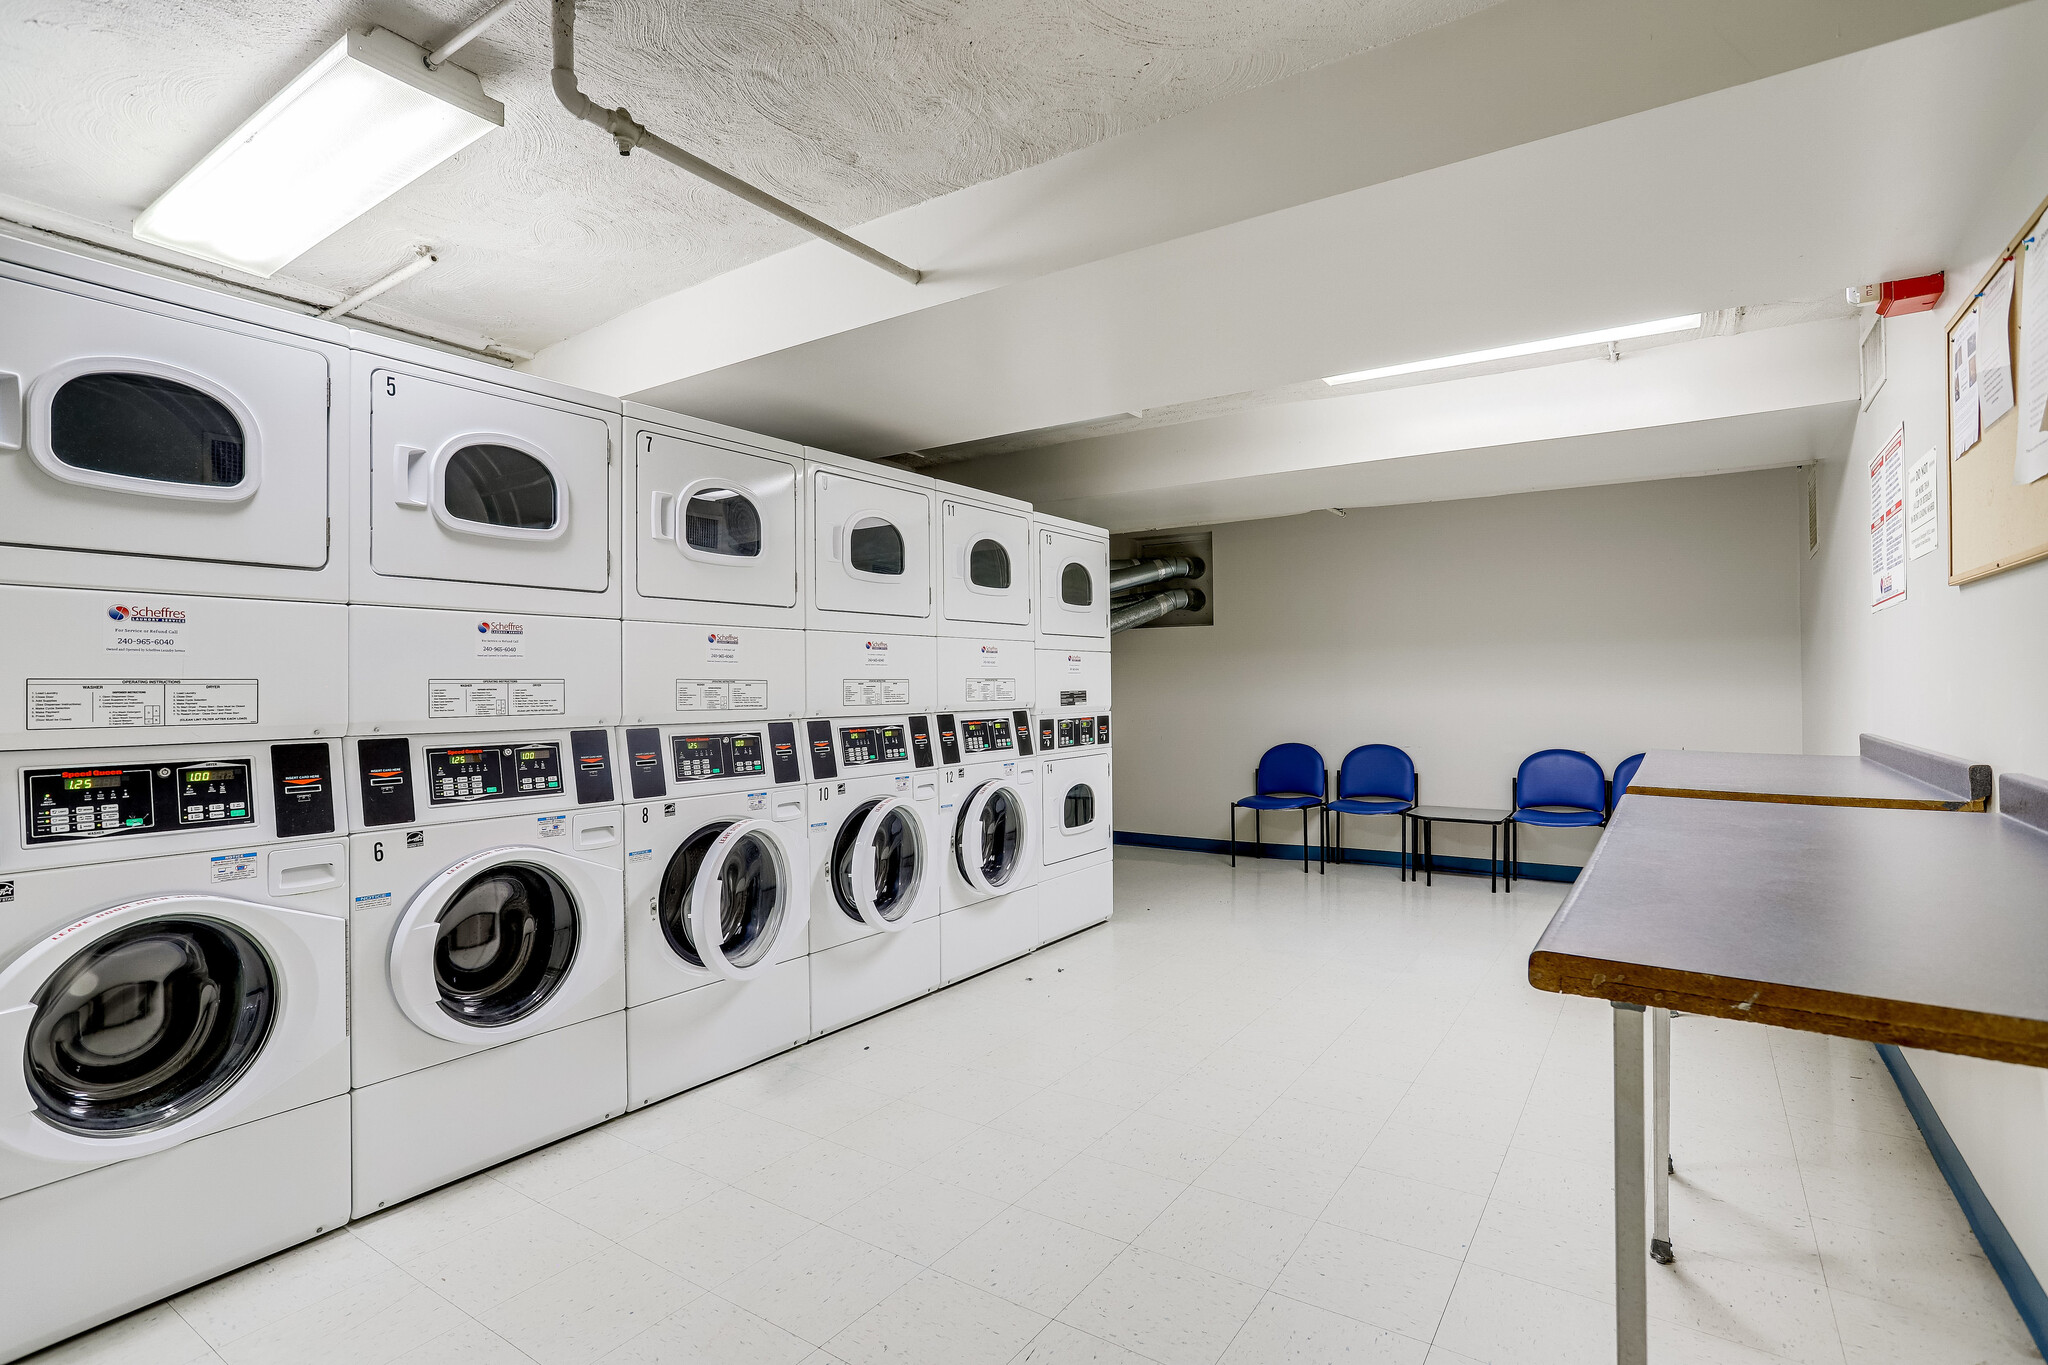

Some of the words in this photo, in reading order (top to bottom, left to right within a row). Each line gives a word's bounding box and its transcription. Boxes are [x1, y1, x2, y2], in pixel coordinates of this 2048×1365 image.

[386, 376, 397, 397] 5
[645, 436, 653, 453] 7
[947, 504, 955, 517] 11
[131, 606, 186, 619] Scheffres
[490, 621, 523, 631] Scheffres
[117, 637, 175, 646] 240-965-6040
[451, 755, 466, 765] 1.25
[522, 752, 535, 760] 1.00
[61, 770, 92, 779] Speed
[93, 769, 123, 777] Queen
[190, 771, 210, 782] 1.00
[946, 770, 954, 783] 12
[69, 779, 92, 790] 1.25
[818, 786, 829, 802] 10
[642, 807, 649, 823] 8
[718, 831, 732, 845] LEAVE
[373, 841, 385, 863] 6
[360, 893, 386, 902] NOTICE
[52, 920, 88, 941] LEAVE
